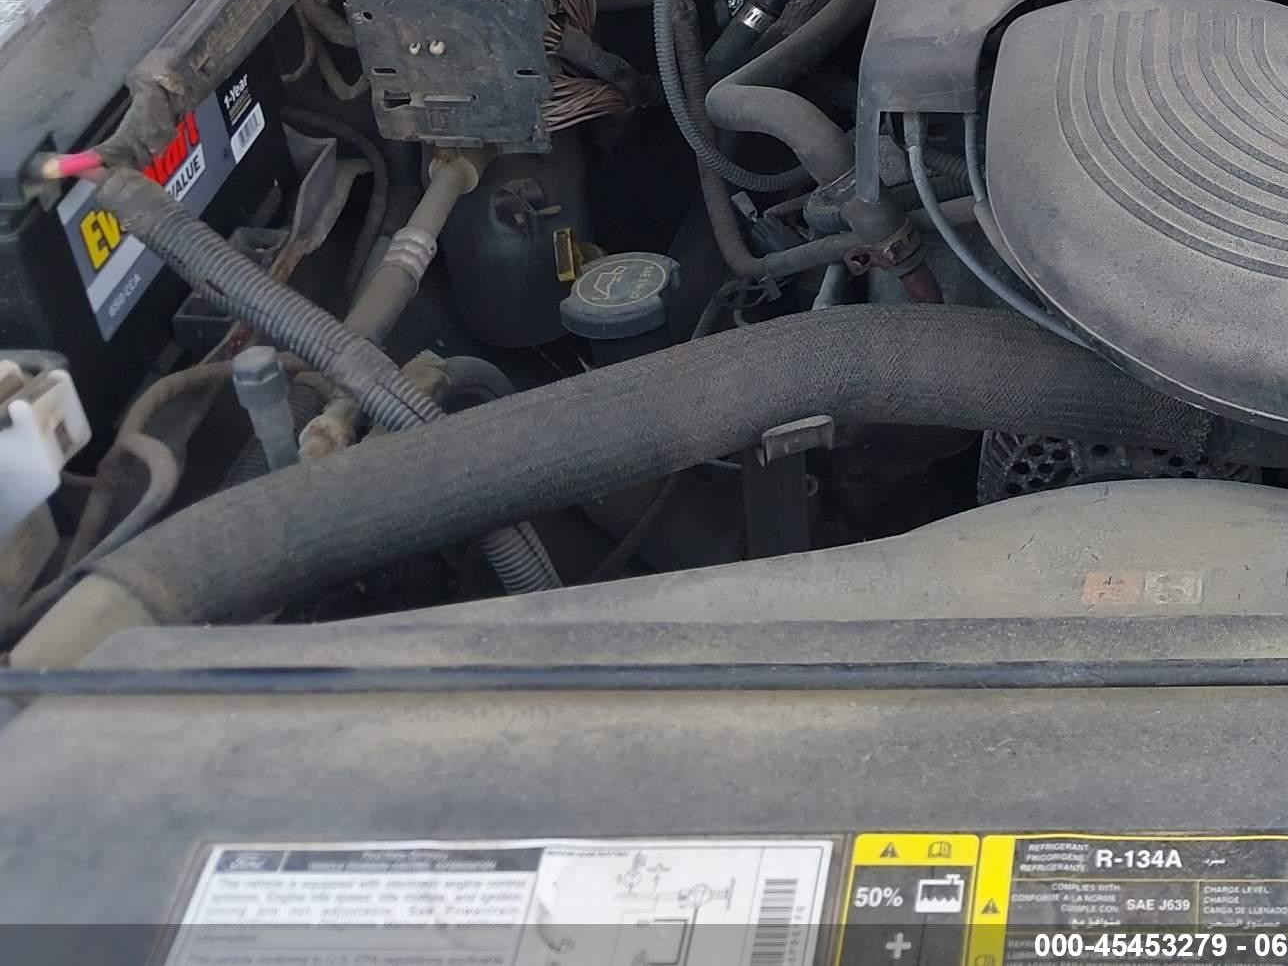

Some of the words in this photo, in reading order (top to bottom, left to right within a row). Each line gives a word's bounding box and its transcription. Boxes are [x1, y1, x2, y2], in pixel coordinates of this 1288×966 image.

[223, 74, 249, 109] 1-Year
[1095, 849, 1183, 869] R-134A
[853, 886, 904, 908] 50%
[1125, 899, 1155, 911] SAE
[1158, 899, 1191, 911] J639
